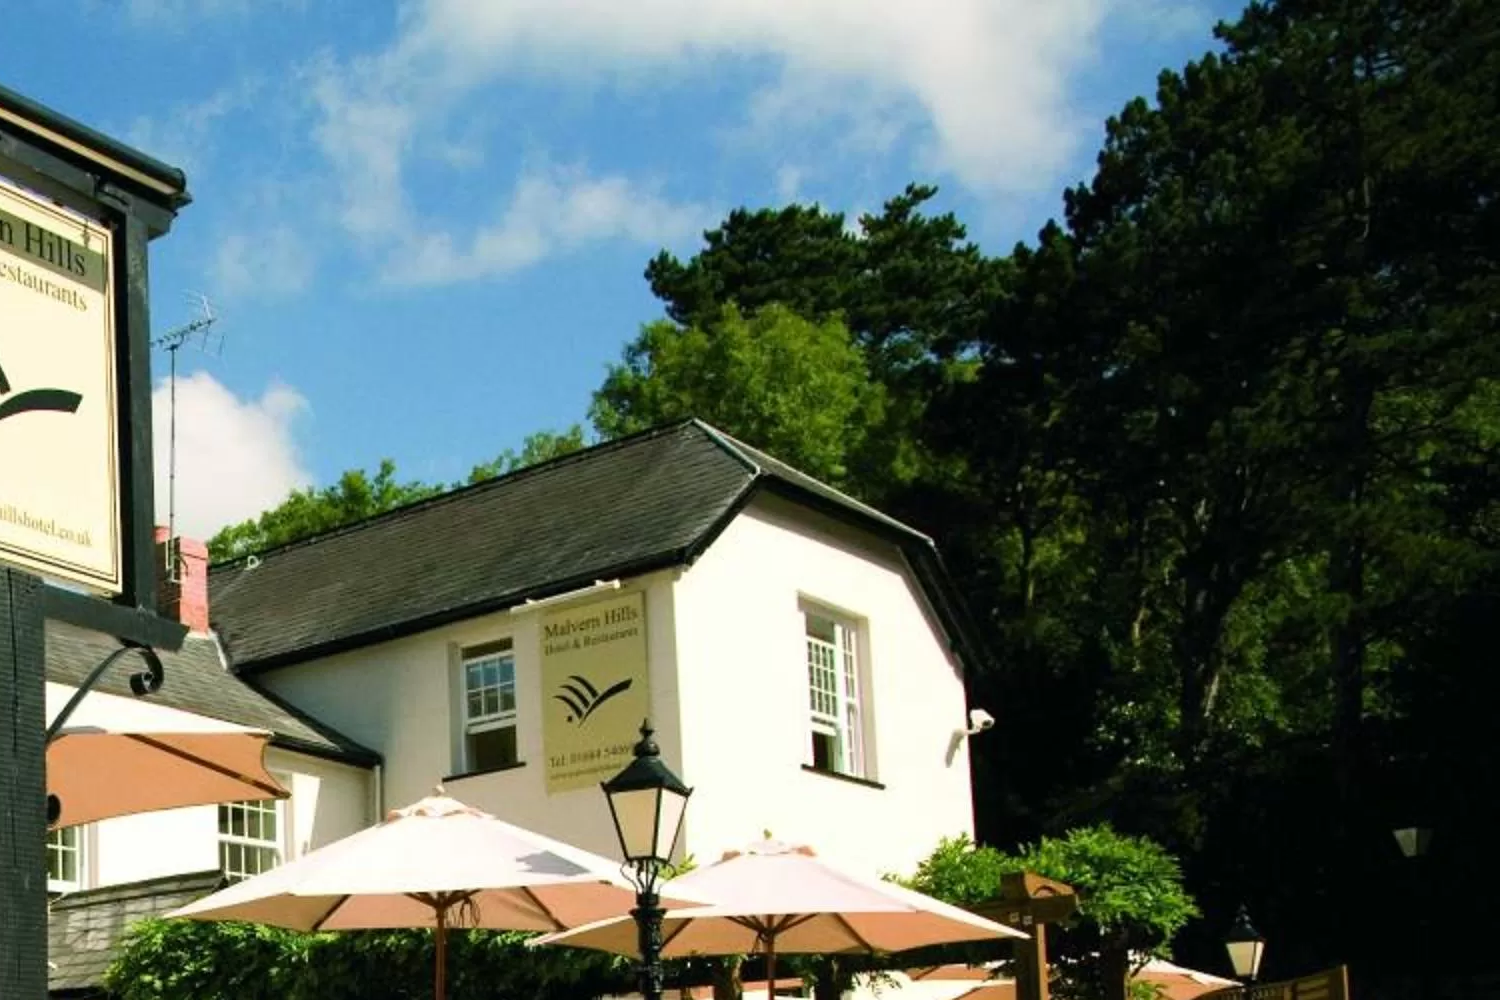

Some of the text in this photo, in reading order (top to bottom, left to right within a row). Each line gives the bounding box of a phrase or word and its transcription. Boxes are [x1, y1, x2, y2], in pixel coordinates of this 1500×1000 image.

[25, 221, 86, 277] Hills
[544, 606, 638, 641] Malvern Hills
